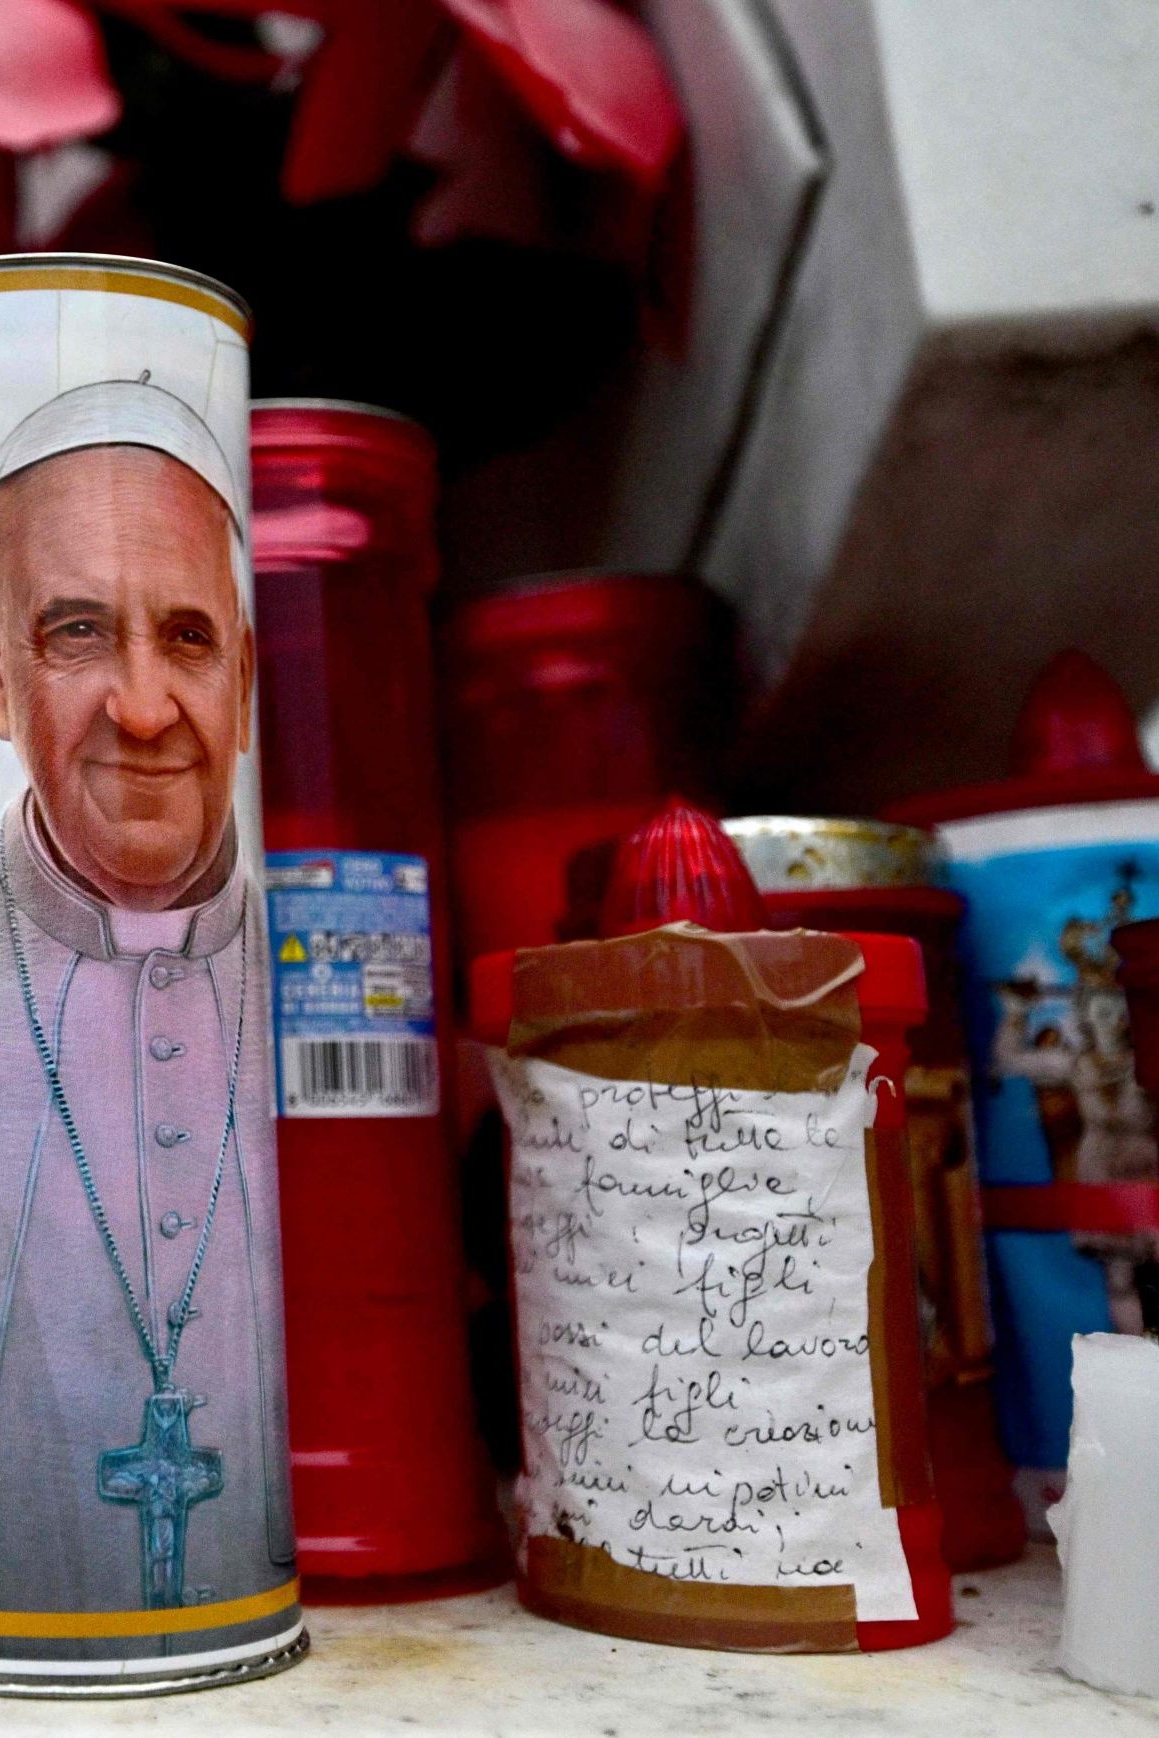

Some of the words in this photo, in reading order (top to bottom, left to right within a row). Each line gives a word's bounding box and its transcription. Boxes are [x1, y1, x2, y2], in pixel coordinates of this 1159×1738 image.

[610, 1118, 660, 1154] di
[673, 1252, 821, 1329] figli
[642, 1318, 721, 1357] del
[742, 1320, 870, 1359] lavoro
[632, 1364, 751, 1436] figli
[660, 1465, 852, 1518] nipotini
